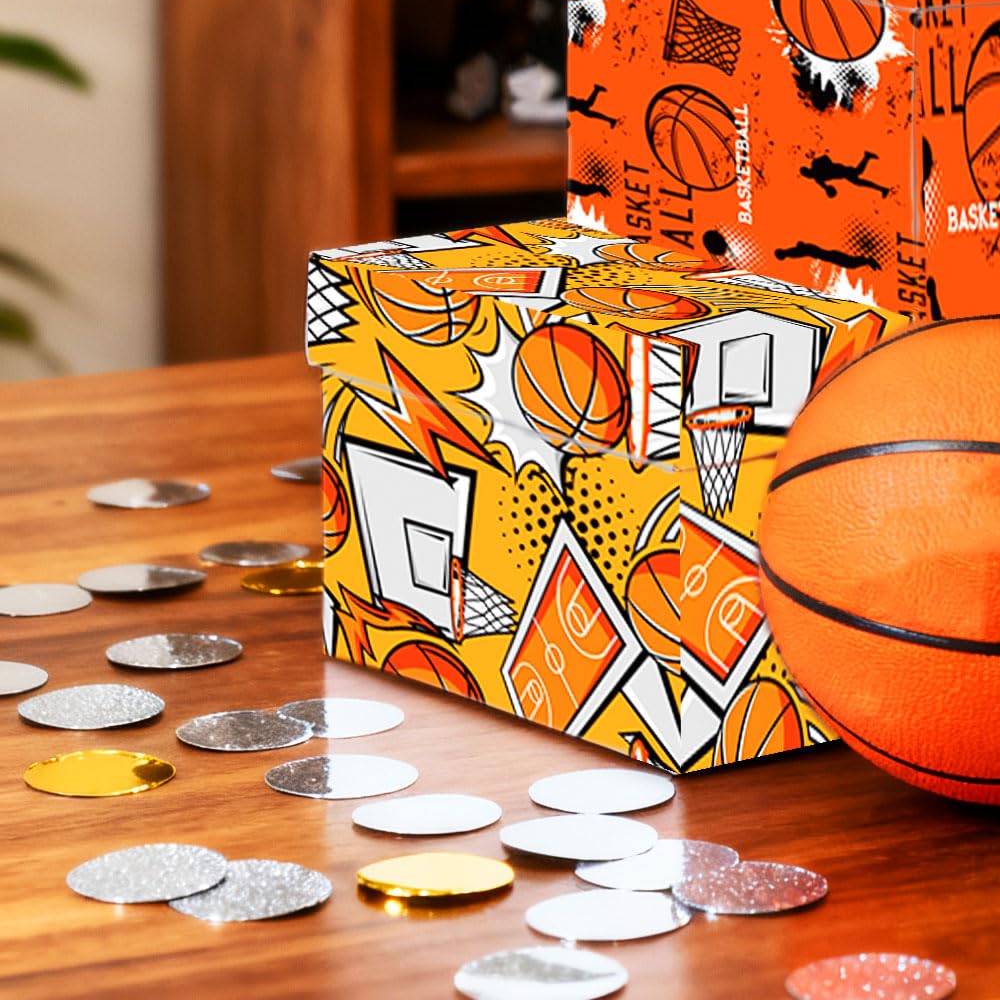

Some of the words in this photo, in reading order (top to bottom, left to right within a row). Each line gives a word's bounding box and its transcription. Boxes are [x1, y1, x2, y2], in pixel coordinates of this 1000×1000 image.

[919, 46, 964, 117] LL
[734, 103, 752, 225] BASKETBALL
[658, 185, 695, 250] ALL
